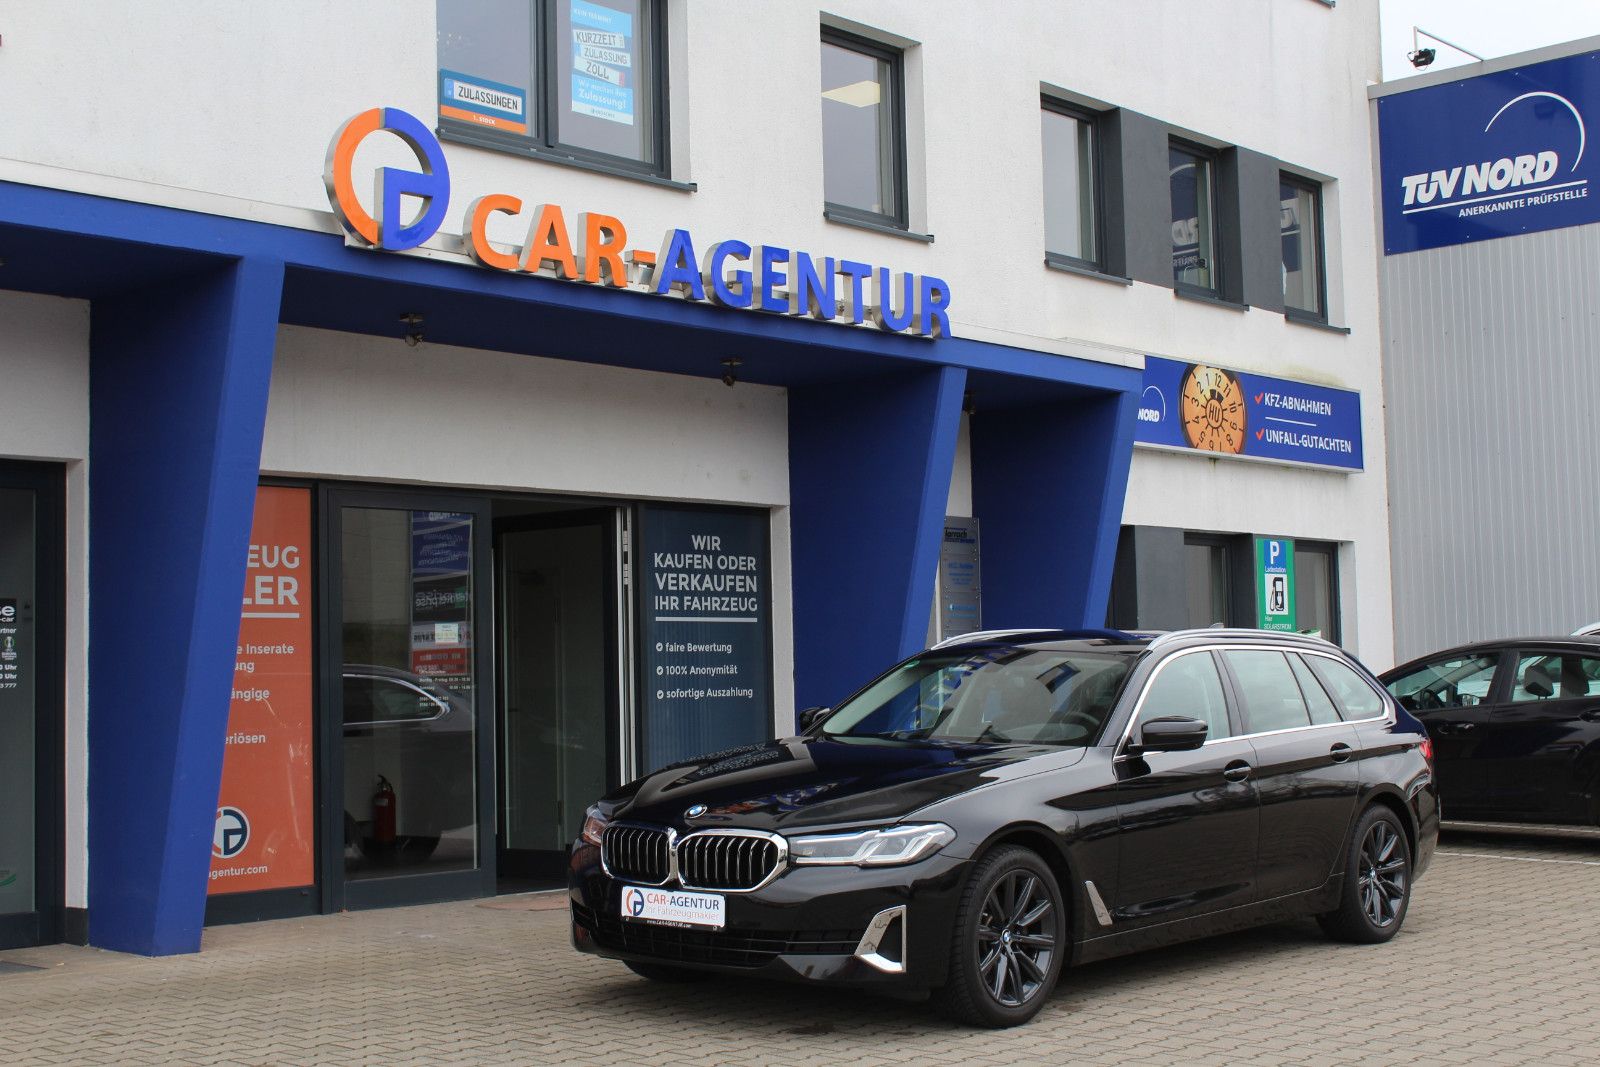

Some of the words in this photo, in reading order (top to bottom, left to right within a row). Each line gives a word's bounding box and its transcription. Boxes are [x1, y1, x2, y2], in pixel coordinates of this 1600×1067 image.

[575, 31, 616, 46] KURZZEIT
[584, 47, 627, 65] ZULASSUNG
[586, 61, 609, 80] ZOLL
[458, 85, 518, 111] ZULASSUNGEN
[1462, 150, 1558, 196] NORD
[1459, 198, 1525, 218] ANERKANNTE
[1528, 187, 1588, 207] PRÜFSTELLE
[463, 193, 951, 339] CAR-AGENTUR
[1196, 381, 1204, 394] 2
[1214, 373, 1222, 388] 12
[1222, 383, 1231, 398] 11
[1191, 397, 1200, 407] 3
[1263, 392, 1332, 417] KFZ-ABNAHMEN
[1137, 407, 1160, 422] NORD
[1208, 402, 1221, 423] HU
[1225, 433, 1234, 446] 8
[1265, 428, 1352, 453] UNFALL-GUTACHTEN
[691, 534, 721, 551] WIR
[653, 552, 713, 569] KAUFEN
[717, 555, 757, 571] ODER
[1269, 541, 1280, 565] P
[655, 572, 757, 593] VERKAUFEN
[654, 595, 679, 611] IHR
[683, 596, 758, 612] FAHRZEUG
[246, 643, 294, 655] Inserate
[665, 642, 685, 653] faire
[687, 643, 732, 654] Bewertung
[666, 665, 688, 676] 100%
[689, 664, 738, 677] Anonymität
[666, 689, 705, 700] sofortige
[706, 687, 753, 699] Auszahlung
[646, 892, 720, 911] CAR-AGENTUR
[657, 905, 720, 921] Fahrzeugmakler
